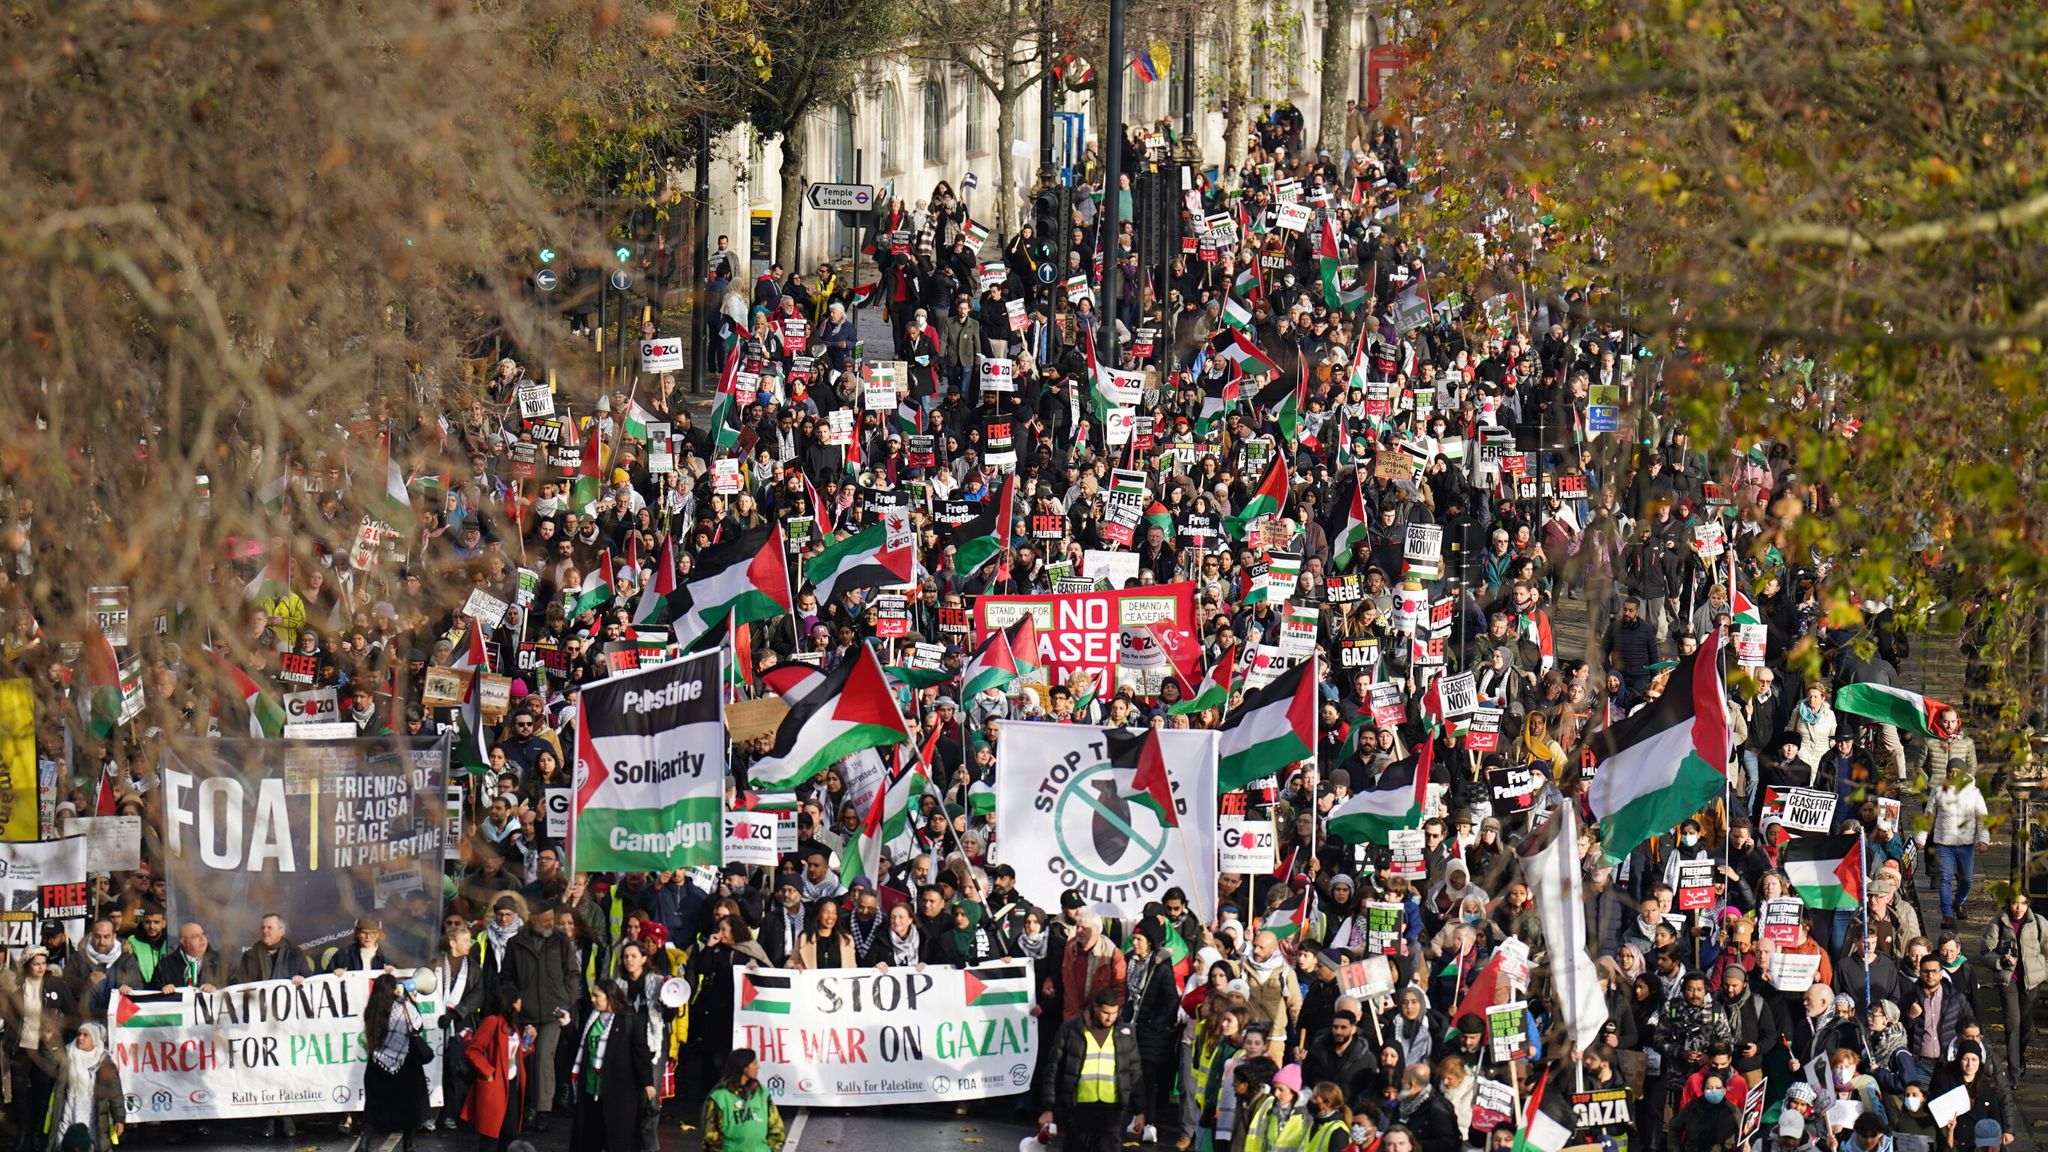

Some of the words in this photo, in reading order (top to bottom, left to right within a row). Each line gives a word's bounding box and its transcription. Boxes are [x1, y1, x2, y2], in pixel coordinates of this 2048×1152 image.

[823, 187, 853, 197] Temple
[823, 198, 853, 206] station
[1281, 205, 1307, 220] Gza
[1262, 255, 1285, 270] GAZA
[642, 344, 679, 357] Gza
[982, 362, 1010, 375] Gza
[1107, 371, 1141, 389] Gza
[521, 389, 550, 401] CEASEFIRE
[525, 399, 550, 413] NOW!
[532, 425, 560, 443] GAZA
[987, 423, 1011, 439] FREE
[558, 448, 580, 458] Free
[1172, 449, 1196, 463] AZA
[1386, 453, 1405, 461] STOP
[1481, 447, 1502, 458] FRE
[549, 455, 582, 467] Palesti
[1378, 460, 1409, 470] BOMBING
[1385, 468, 1402, 476] GAZA
[1521, 483, 1553, 498] GAA
[1559, 477, 1587, 491] FREE
[875, 492, 897, 504] Free
[1109, 492, 1142, 506] FREE
[946, 503, 969, 514] Free
[935, 511, 980, 524] Palestin
[1032, 515, 1062, 531] FREE
[1188, 513, 1210, 526] Free
[1032, 530, 1063, 539] PALESTINE
[1178, 523, 1218, 537] Palestine
[1408, 528, 1441, 542] CEASEFIRE
[888, 537, 910, 549] Gza
[1409, 540, 1436, 556] NOW!
[1252, 563, 1268, 577] CEASE
[1057, 582, 1094, 593] CEASEFIRE
[1268, 580, 1295, 588] LESTINE
[1327, 577, 1342, 588] END
[1343, 575, 1359, 586] THE
[1328, 586, 1361, 603] SIEGE
[879, 600, 905, 608] FREEDOM
[989, 606, 1018, 616] STAND
[1033, 606, 1049, 616] FOR
[1129, 602, 1159, 611] DEMAND
[1163, 602, 1170, 611] A
[1432, 601, 1453, 621] FREE
[878, 611, 906, 619] PALESTINE
[997, 617, 1040, 626] HUMAY
[1059, 599, 1108, 630] NO
[1124, 612, 1171, 622] CEASEFIRE
[1121, 632, 1158, 652] Gza
[1282, 631, 1315, 640] PALESTINE
[519, 651, 536, 670] GA
[539, 649, 568, 670] FREE
[610, 650, 639, 671] FREE
[916, 649, 942, 660] FREEDOM
[1244, 649, 1284, 670] Gza
[1342, 647, 1378, 666] GAZA
[282, 654, 318, 674] FREE
[914, 659, 941, 669] PALESTINE
[280, 671, 314, 684] PALESTINE
[1372, 687, 1398, 698] FREEDOM
[1441, 676, 1475, 695] CEASEFIRE
[288, 697, 335, 717] Gza
[1447, 690, 1477, 711] NOW!
[1474, 713, 1500, 723] FREEDOM
[1470, 724, 1499, 733] PALESTINE
[335, 775, 407, 799] FRIENDS
[413, 768, 432, 790] OF
[849, 765, 878, 788] pressed
[1035, 750, 1081, 813] STOP
[335, 795, 408, 823] AL-AQSA
[1222, 794, 1248, 815] FREE
[1788, 795, 1834, 812] CEASEFIRE
[165, 768, 296, 872] FOA
[551, 818, 566, 826] Stop
[1790, 806, 1827, 826] NOW!
[335, 821, 389, 845] PEACE
[725, 819, 772, 838] Gza
[1223, 828, 1272, 848] Gza
[335, 847, 352, 868] IN
[358, 827, 441, 866] PALESTINE
[1682, 866, 1712, 877] FREEDOM
[1047, 856, 1175, 903] COALITION
[1681, 878, 1713, 887] PALESTINE
[43, 884, 87, 908] FREE
[1687, 889, 1708, 898] الحرية
[1684, 896, 1711, 907] لفلسطين
[1769, 903, 1800, 913] FREEDOM
[44, 906, 87, 919] PALESTINE
[1767, 915, 1799, 925] PALESTINE
[0, 921, 33, 946] AZA
[817, 973, 933, 1014] STOP
[193, 980, 358, 1026] NATIONAL
[741, 1024, 791, 1065] THE
[800, 1027, 868, 1065] WAR
[879, 1025, 924, 1063] ON
[936, 1016, 1029, 1060] GAZA!
[117, 1039, 217, 1073] MARCH
[228, 1036, 280, 1069] FOR
[290, 1028, 369, 1066] PALES
[837, 1080, 862, 1094] Rally
[864, 1079, 878, 1091] For
[881, 1078, 924, 1092] Palestine
[958, 1077, 977, 1090] FOA
[232, 1091, 259, 1105] Rally
[261, 1090, 277, 1102] For
[279, 1088, 324, 1102] Palestine
[1572, 1094, 1591, 1103] STOP
[1591, 1090, 1627, 1100] BOMBING
[1572, 1100, 1631, 1128] GAZA
